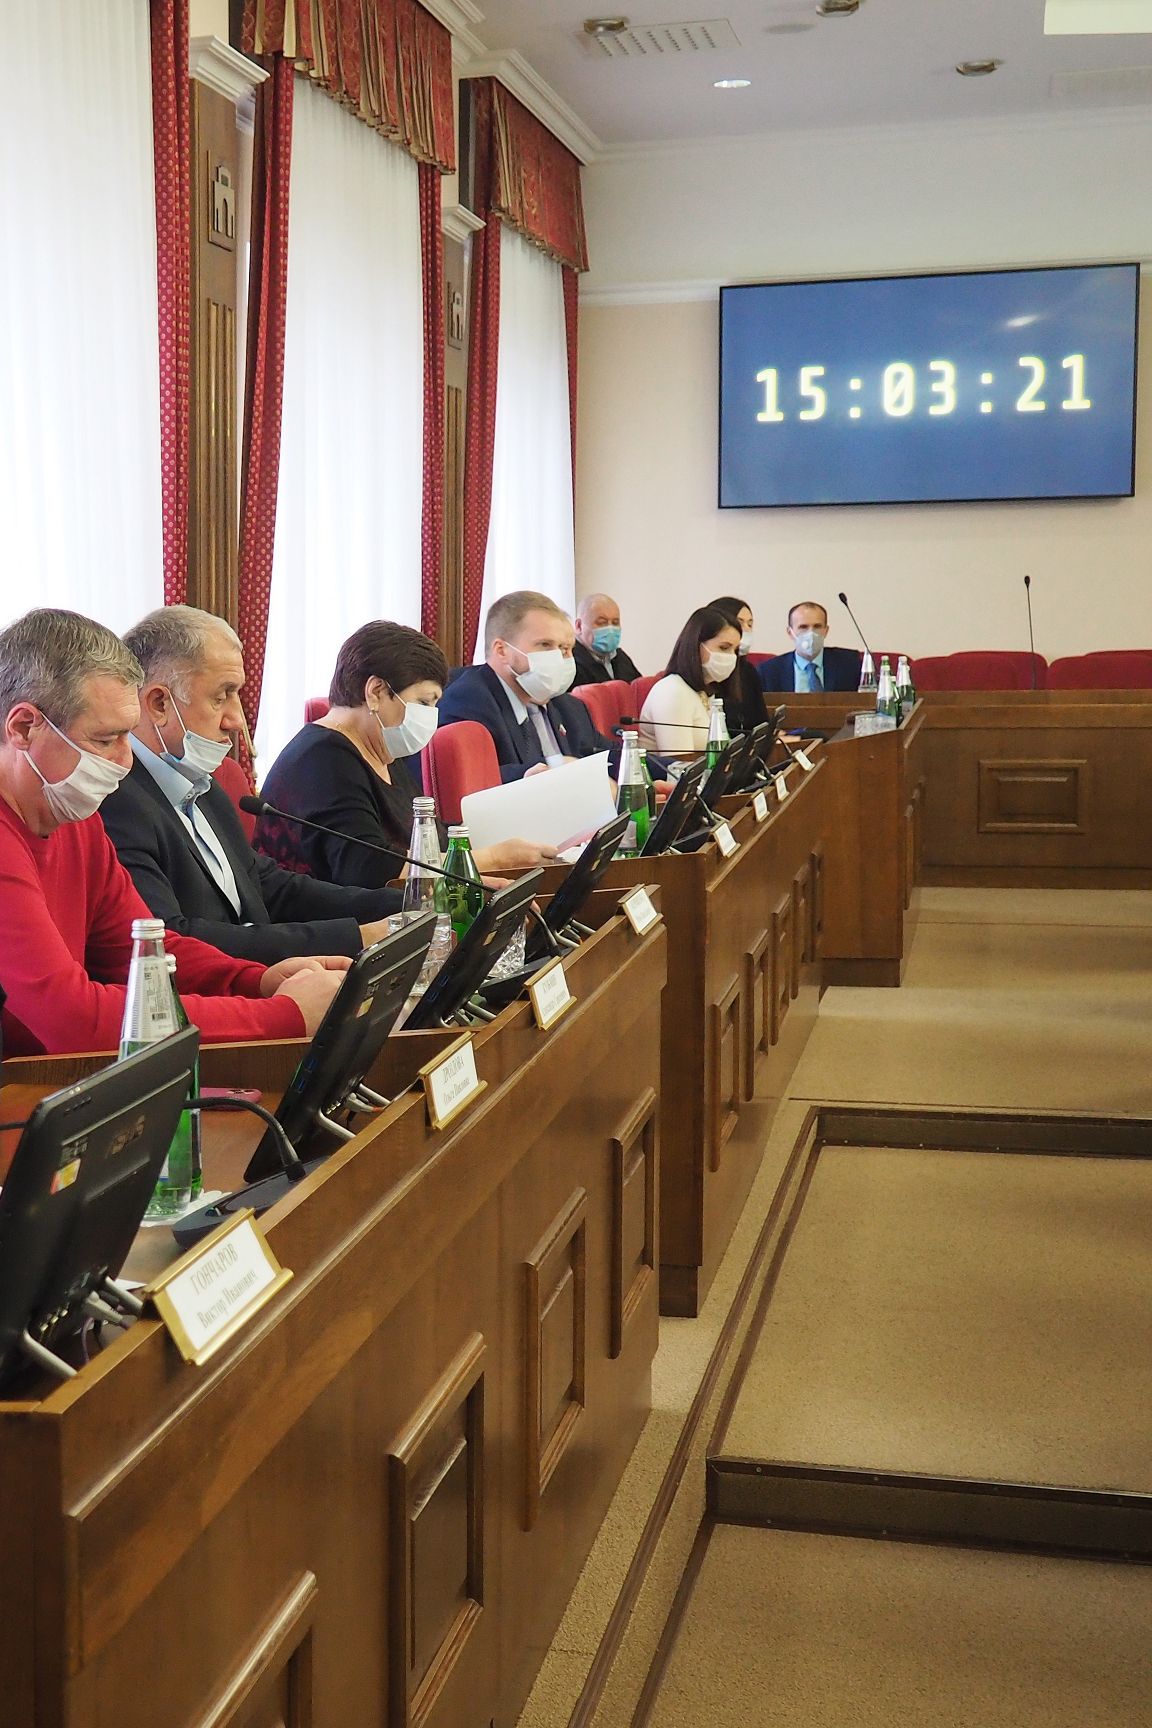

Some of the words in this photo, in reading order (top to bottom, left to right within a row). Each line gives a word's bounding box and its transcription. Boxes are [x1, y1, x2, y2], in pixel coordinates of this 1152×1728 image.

[756, 354, 1091, 422] 15:03:21
[190, 1243, 239, 1296] ГОНЧАРОВ
[197, 1298, 229, 1329] Виктор
